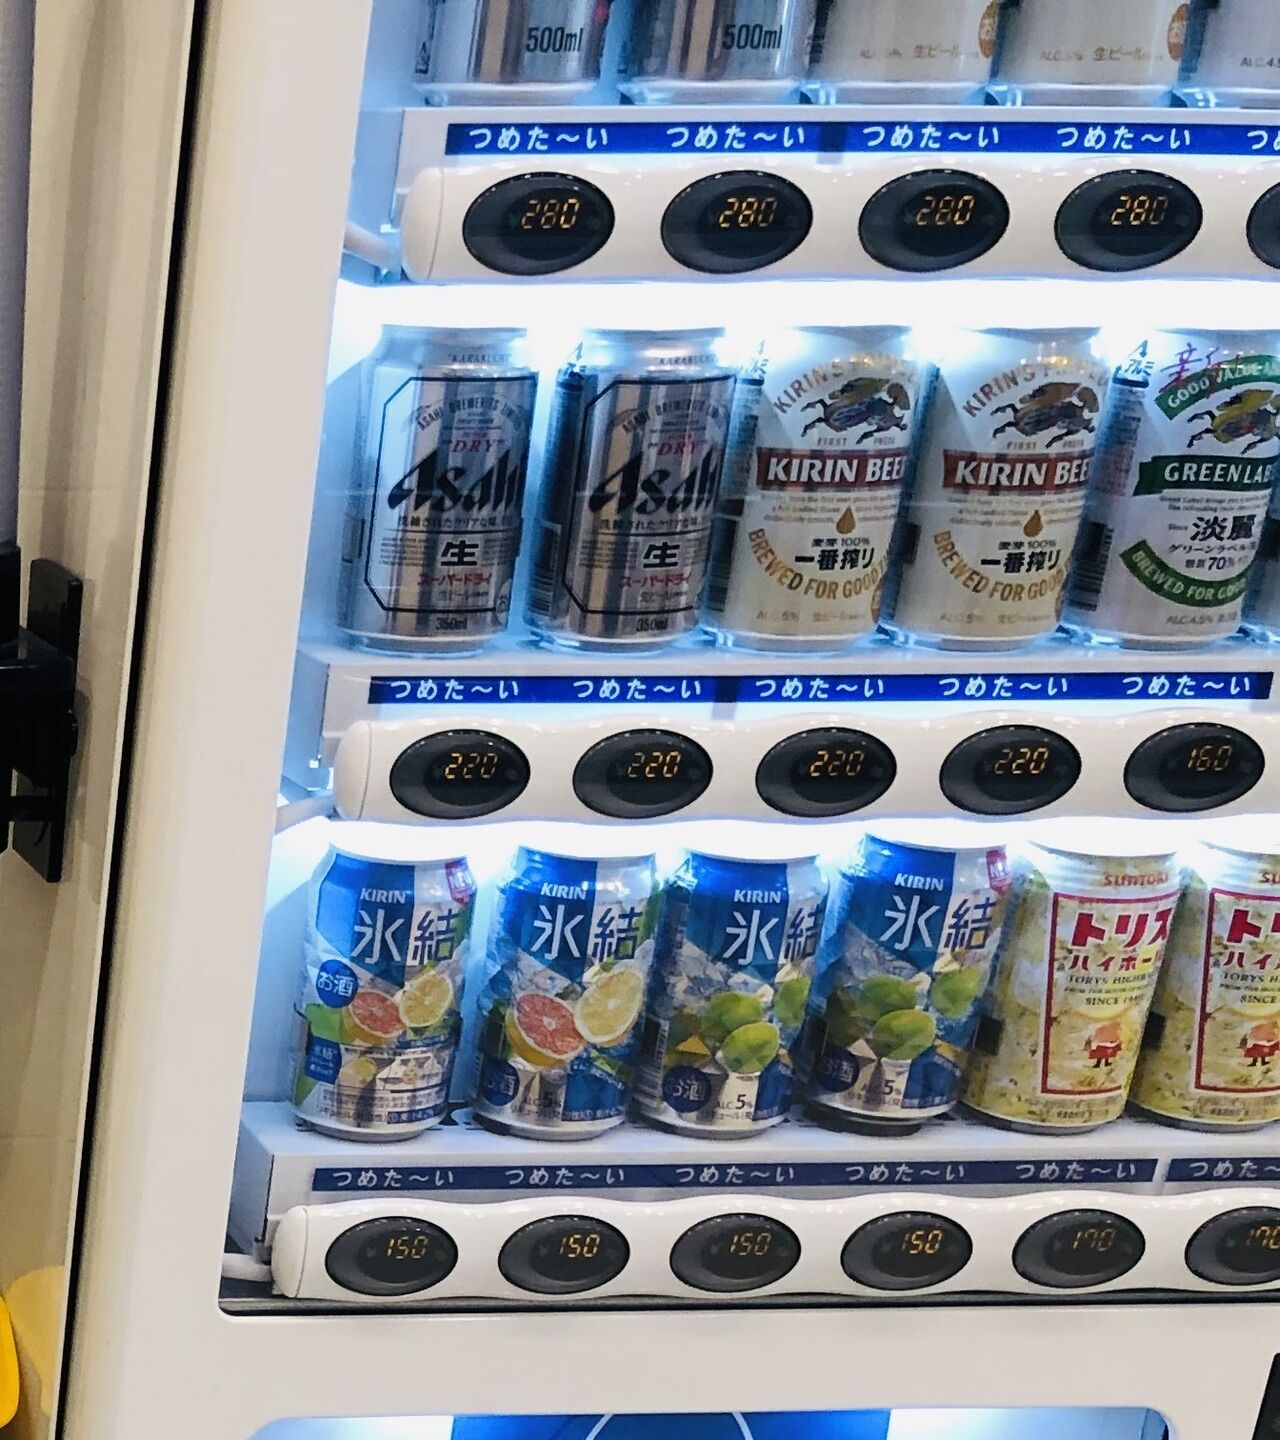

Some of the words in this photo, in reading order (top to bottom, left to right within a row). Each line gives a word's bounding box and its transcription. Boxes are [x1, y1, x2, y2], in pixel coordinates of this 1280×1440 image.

[525, 26, 583, 53] 500ml
[721, 24, 783, 50] 500ml
[521, 198, 578, 229] 280
[718, 197, 776, 228] 280
[916, 195, 974, 226] 280
[1111, 195, 1169, 226] 280
[1168, 377, 1210, 408] GOOD
[388, 448, 519, 513] Asah
[589, 444, 719, 516] Asah
[767, 456, 860, 484] KIRIN
[865, 454, 907, 483] BEE
[954, 460, 1046, 487] KIRIN
[1164, 461, 1242, 484] GREEN
[1243, 463, 1272, 485] LAB
[440, 539, 479, 567] 生
[643, 541, 681, 569] 生
[748, 527, 804, 592] BREWED
[803, 577, 839, 601] FOR
[842, 564, 880, 600] GOOD
[794, 547, 875, 571] 一番搾り
[933, 529, 990, 595] BREWED
[990, 580, 1025, 602] FOR
[980, 548, 1061, 575] 一番搾り
[1132, 549, 1185, 595] BREWED
[1186, 584, 1215, 601] FOR
[444, 752, 498, 781] 220
[626, 751, 682, 779] 220
[809, 750, 865, 778] 220
[993, 748, 1050, 776] 220
[1187, 745, 1234, 773] 160
[359, 887, 411, 904] KIRIN
[540, 882, 588, 900] KIRIN
[733, 888, 782, 904] KIRIN
[894, 873, 945, 892] KIRIN
[530, 904, 644, 963] 氷結
[879, 894, 998, 951] 氷結
[1071, 907, 1173, 950] トリス
[350, 908, 460, 967] 氷結
[1223, 951, 1280, 971] ハイ
[317, 971, 356, 997] お酒
[1222, 972, 1265, 984] TORYS
[385, 1235, 429, 1261] 150
[559, 1234, 601, 1259] 150
[729, 1232, 772, 1257] 150
[900, 1229, 943, 1255] 150
[1071, 1227, 1117, 1253] 170
